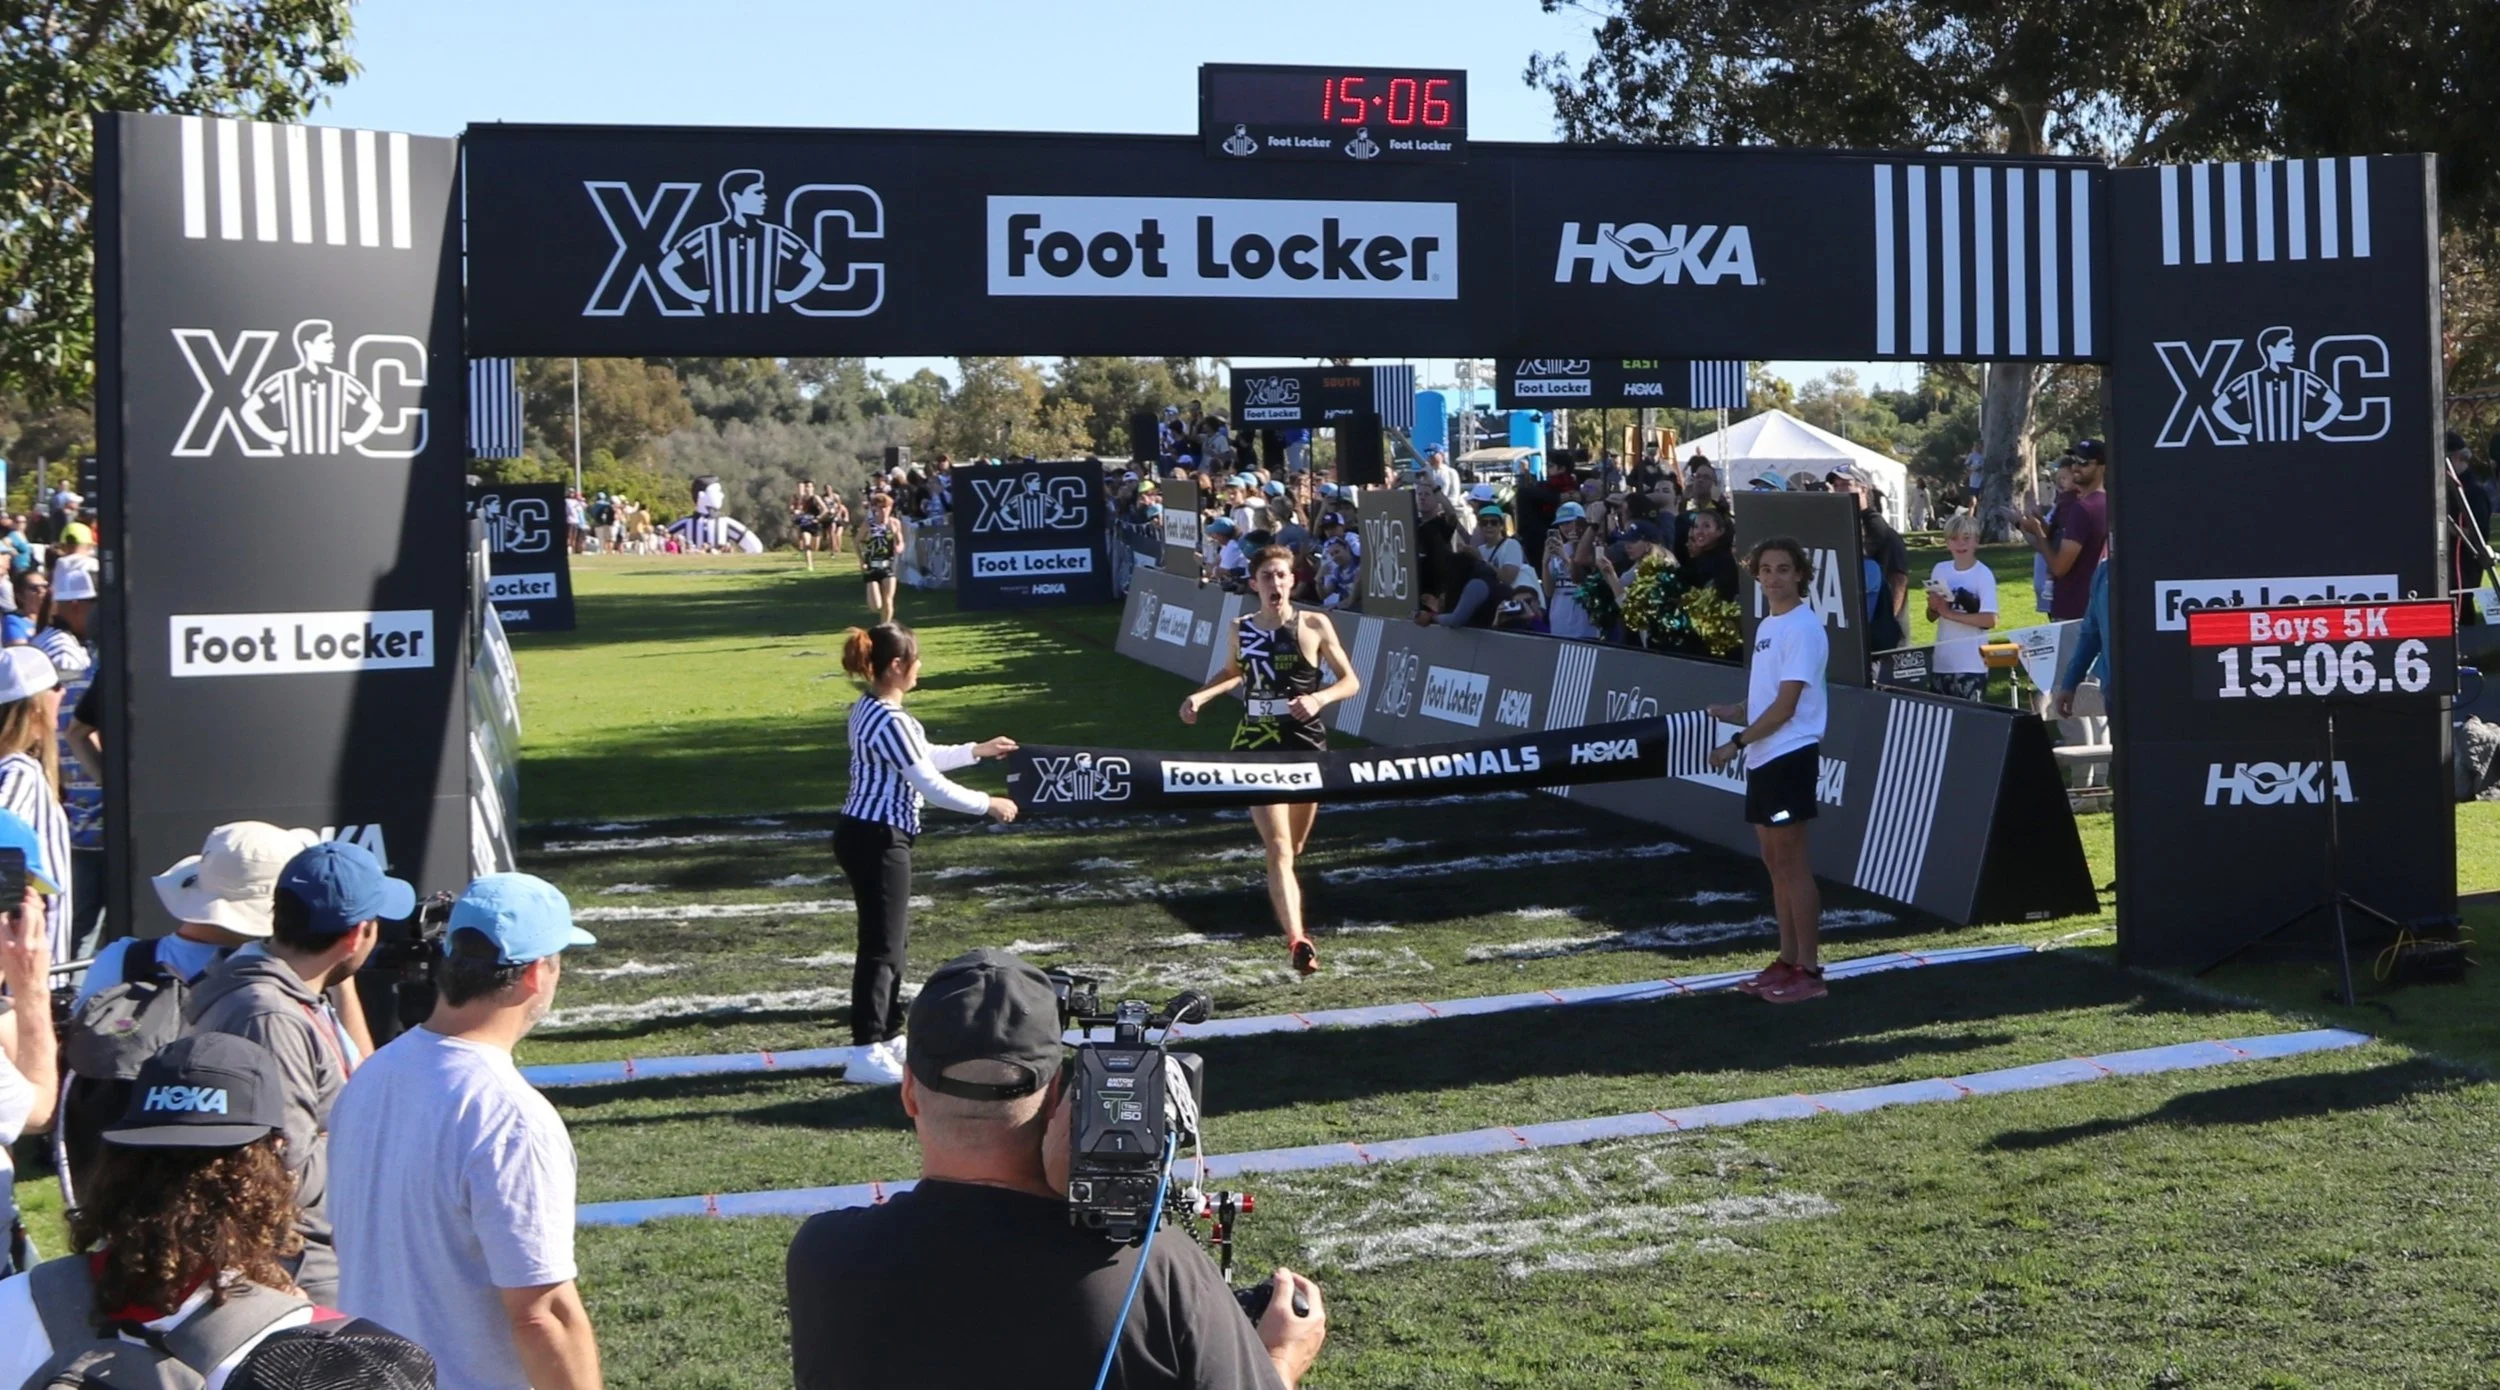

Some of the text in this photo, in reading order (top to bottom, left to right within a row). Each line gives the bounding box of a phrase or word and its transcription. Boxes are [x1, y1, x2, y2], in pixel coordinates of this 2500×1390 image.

[1268, 136, 1332, 149] Foot Locker
[1390, 139, 1452, 152] Foot Locker
[1008, 214, 1439, 281] Foot Locker
[1555, 222, 1758, 286] HOKA
[1324, 377, 1360, 388] SOUTH
[1518, 381, 1588, 394] Foot Locker
[1624, 383, 1664, 396] HOKA
[1247, 409, 1299, 419] Foot Locker
[977, 553, 1087, 573] Foot Locker
[1032, 583, 1066, 595] HOKA
[2250, 608, 2389, 646] Boys 5K
[184, 622, 424, 665] Foot Locker
[2217, 639, 2431, 698] 15:06.6
[1426, 674, 1483, 717] Foot Locker
[1260, 701, 1272, 715] 52
[1495, 688, 1533, 729] HOKA
[1170, 767, 1223, 786] Foot
[1232, 767, 1314, 786] Locker
[1350, 746, 1540, 783] NATIONALS
[1570, 738, 1640, 765] HOKA
[2204, 760, 2353, 805] HOKA
[144, 1086, 228, 1114] HOKA
[1116, 1137, 1122, 1150] 1
